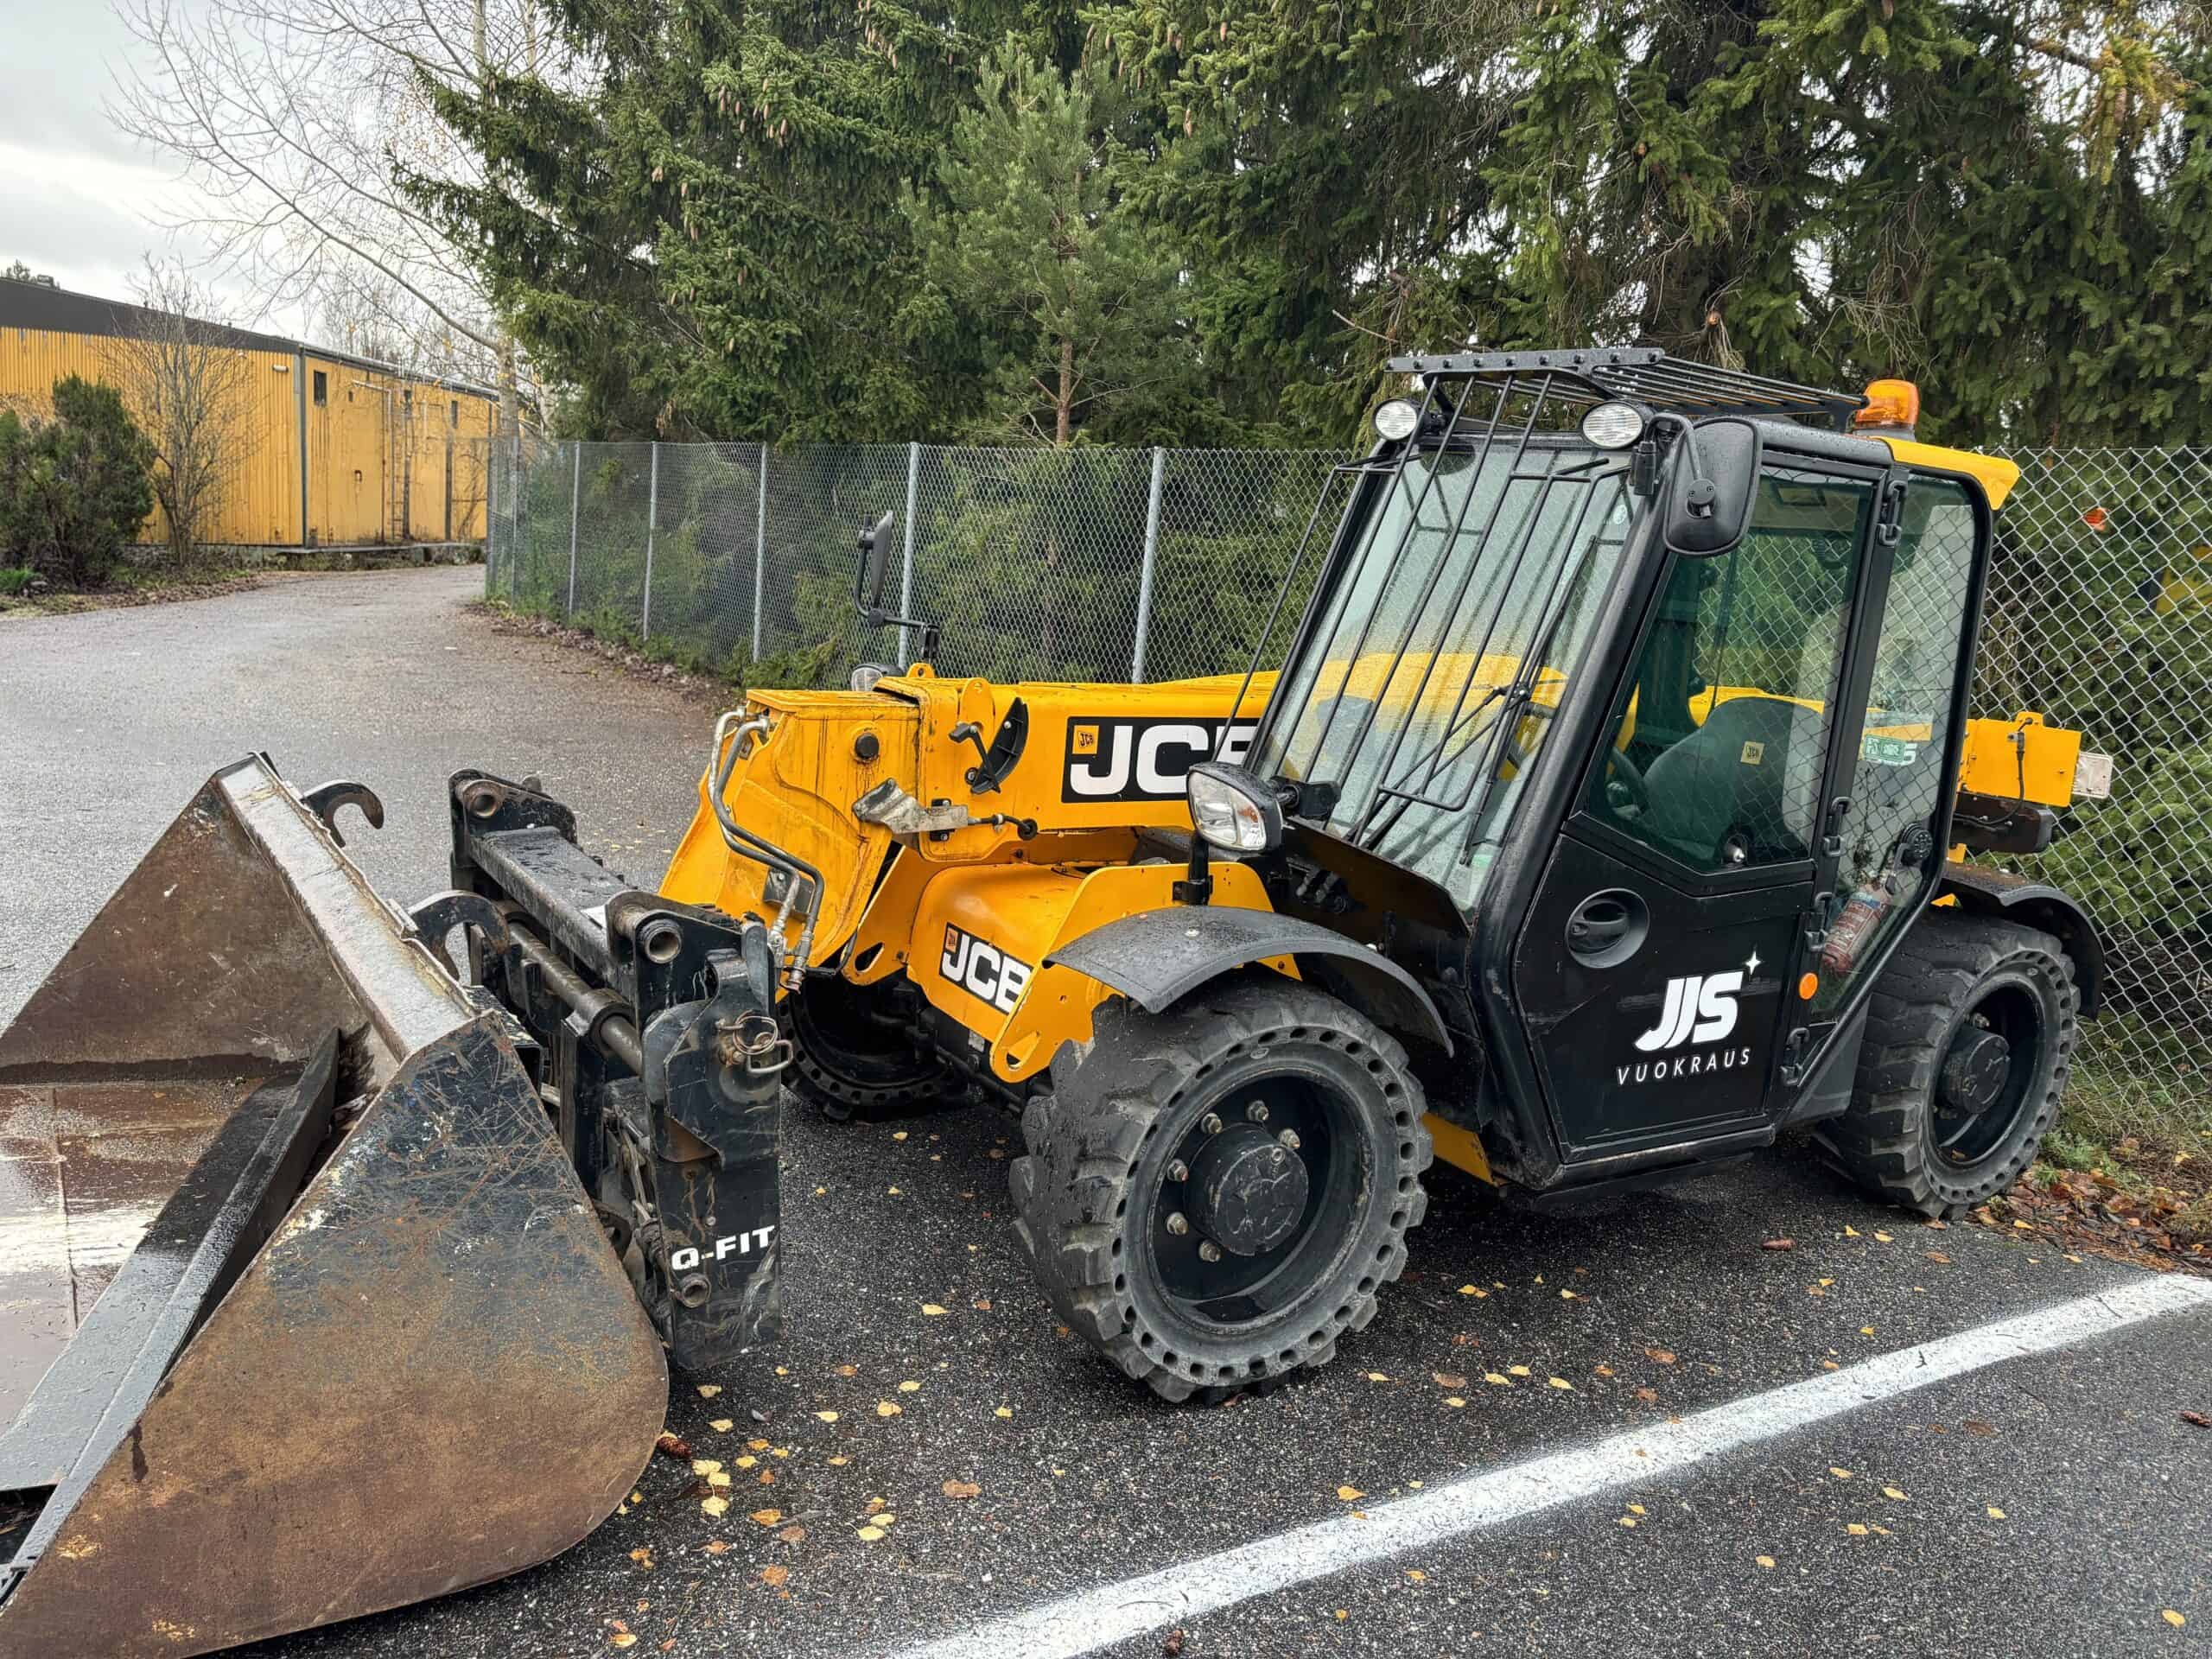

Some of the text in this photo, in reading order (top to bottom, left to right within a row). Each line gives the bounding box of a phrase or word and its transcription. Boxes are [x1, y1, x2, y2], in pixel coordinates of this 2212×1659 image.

[942, 933, 1032, 1014] JCB
[1634, 971, 1744, 1052] JJS
[1617, 1048, 1751, 1086] VUOKRAUS
[671, 1225, 775, 1271] Q-FIT
